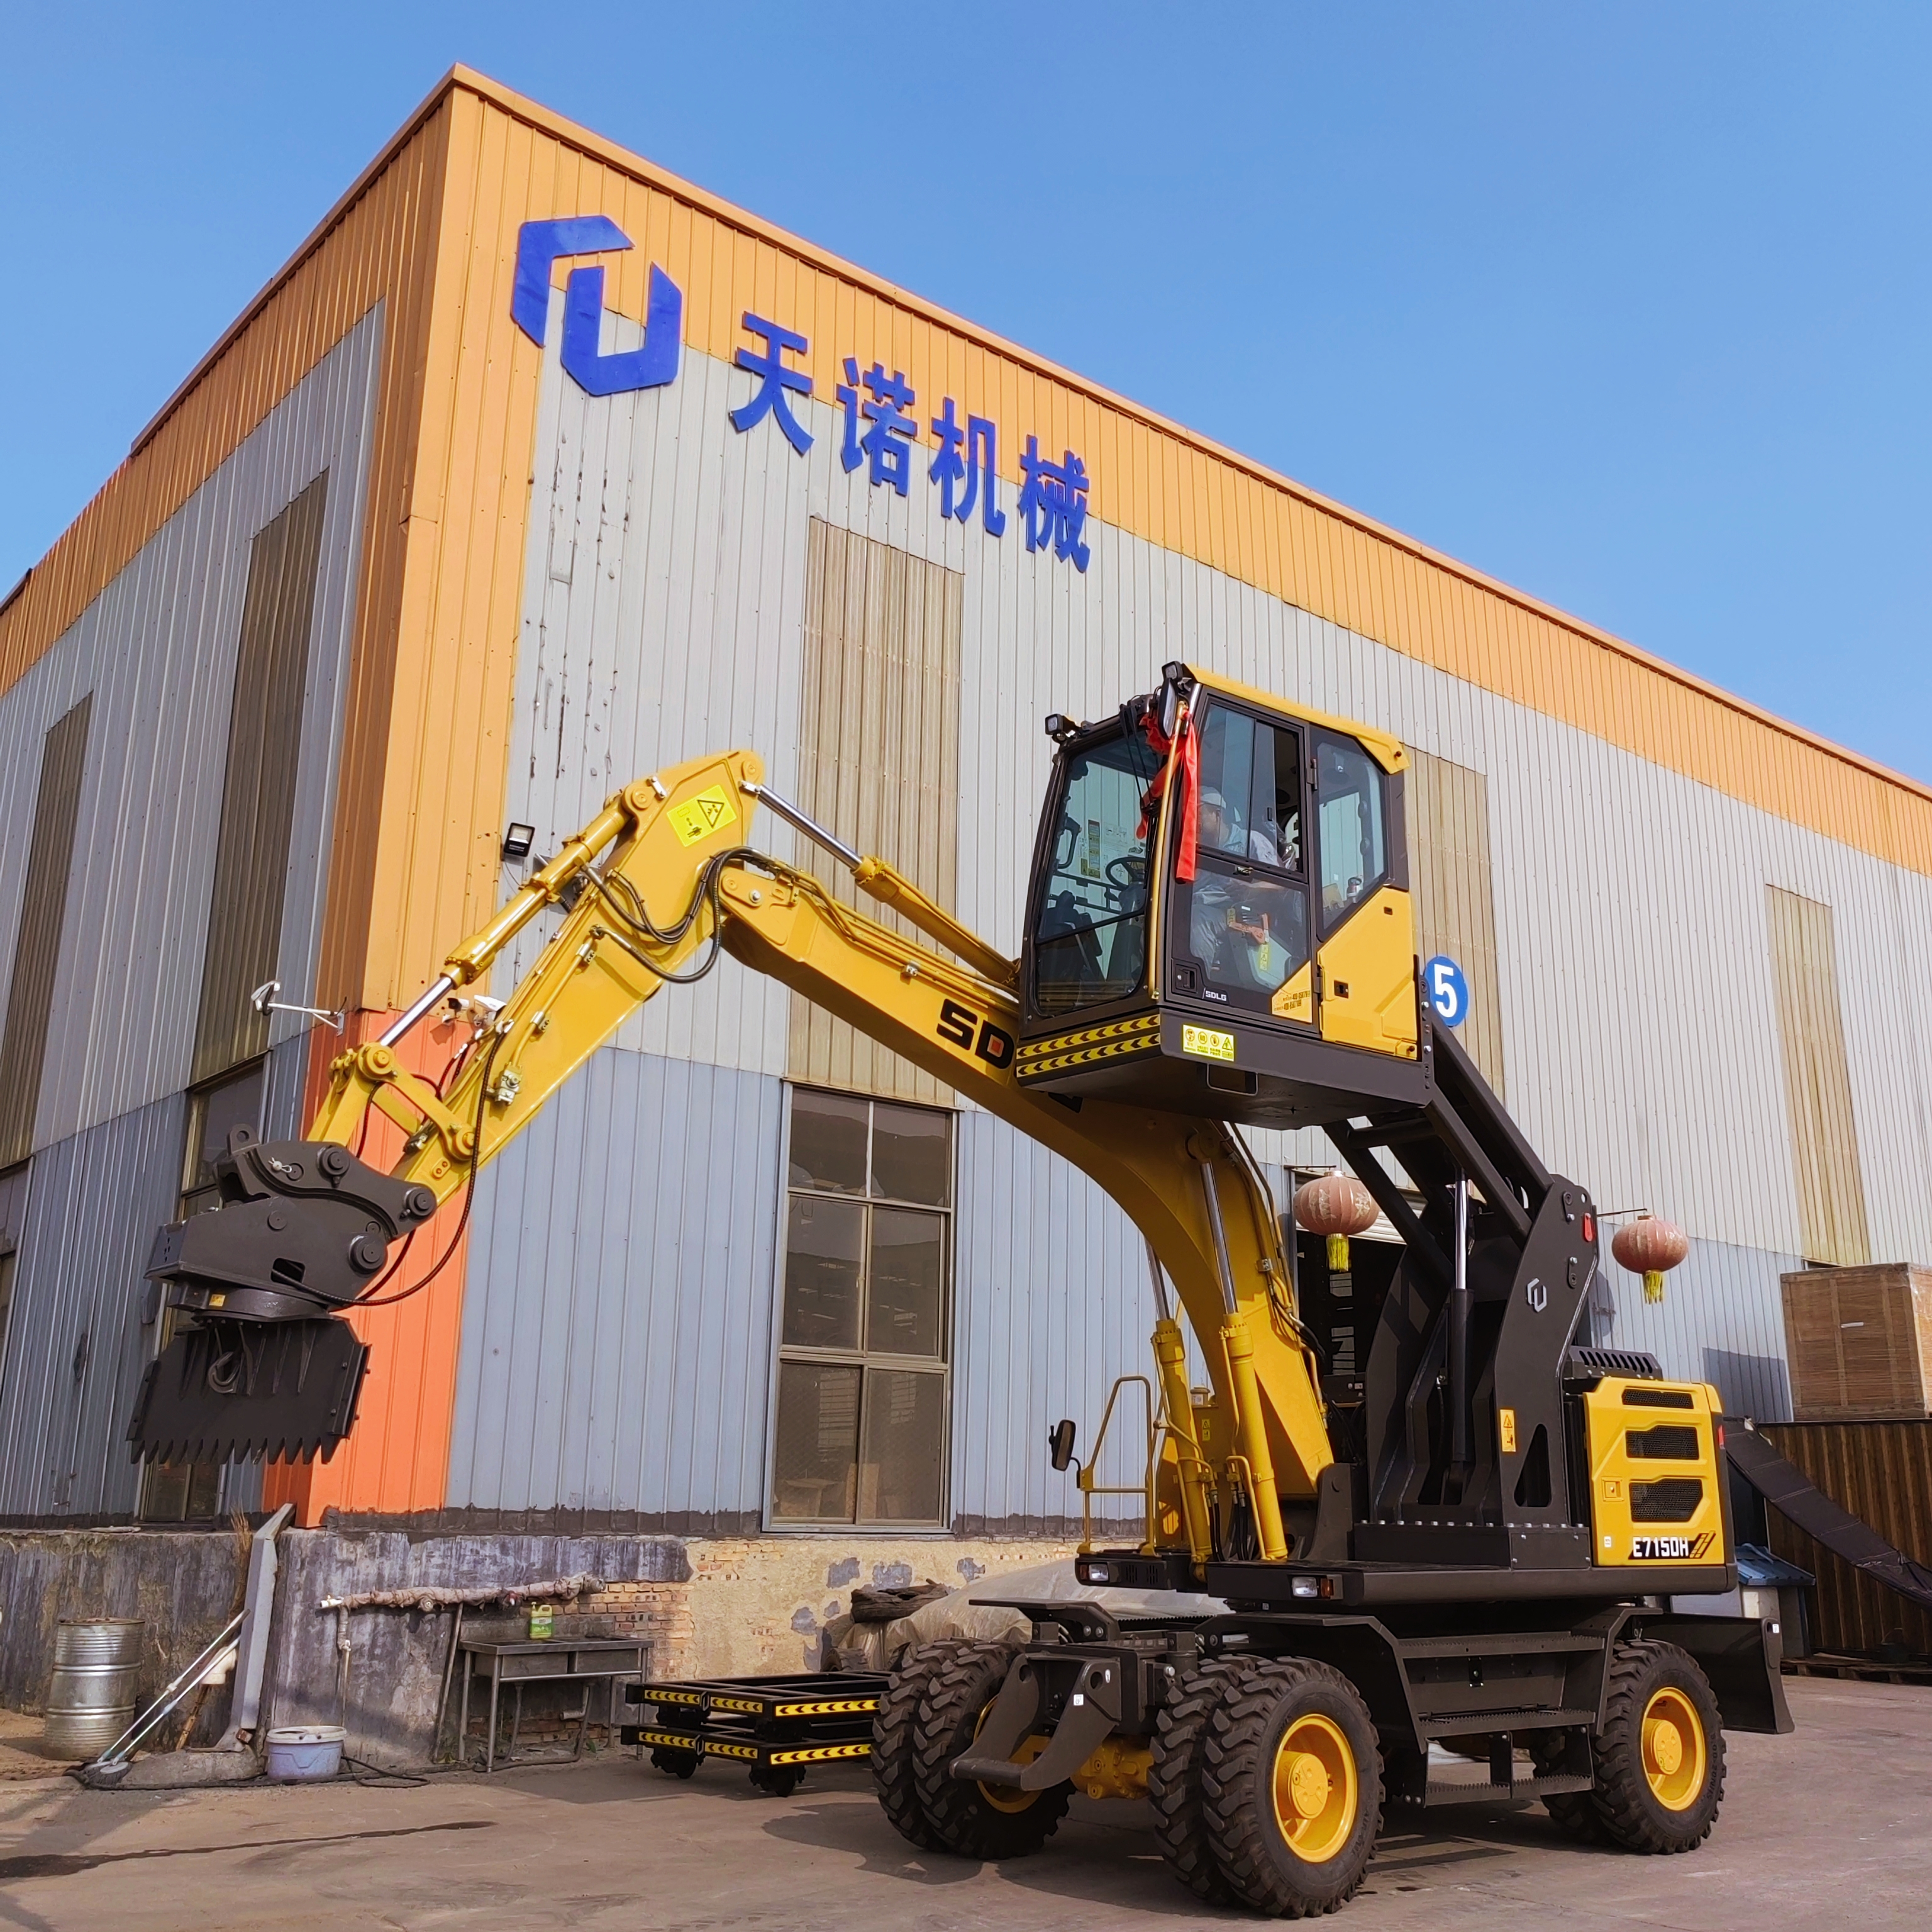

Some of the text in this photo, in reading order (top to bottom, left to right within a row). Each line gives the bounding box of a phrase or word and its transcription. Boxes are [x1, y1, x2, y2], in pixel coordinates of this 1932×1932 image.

[729, 311, 1091, 573] 天诺机械
[1206, 991, 1227, 1001] SDLG
[1434, 963, 1457, 1018] 5
[1633, 1536, 1689, 1557] E7150H
